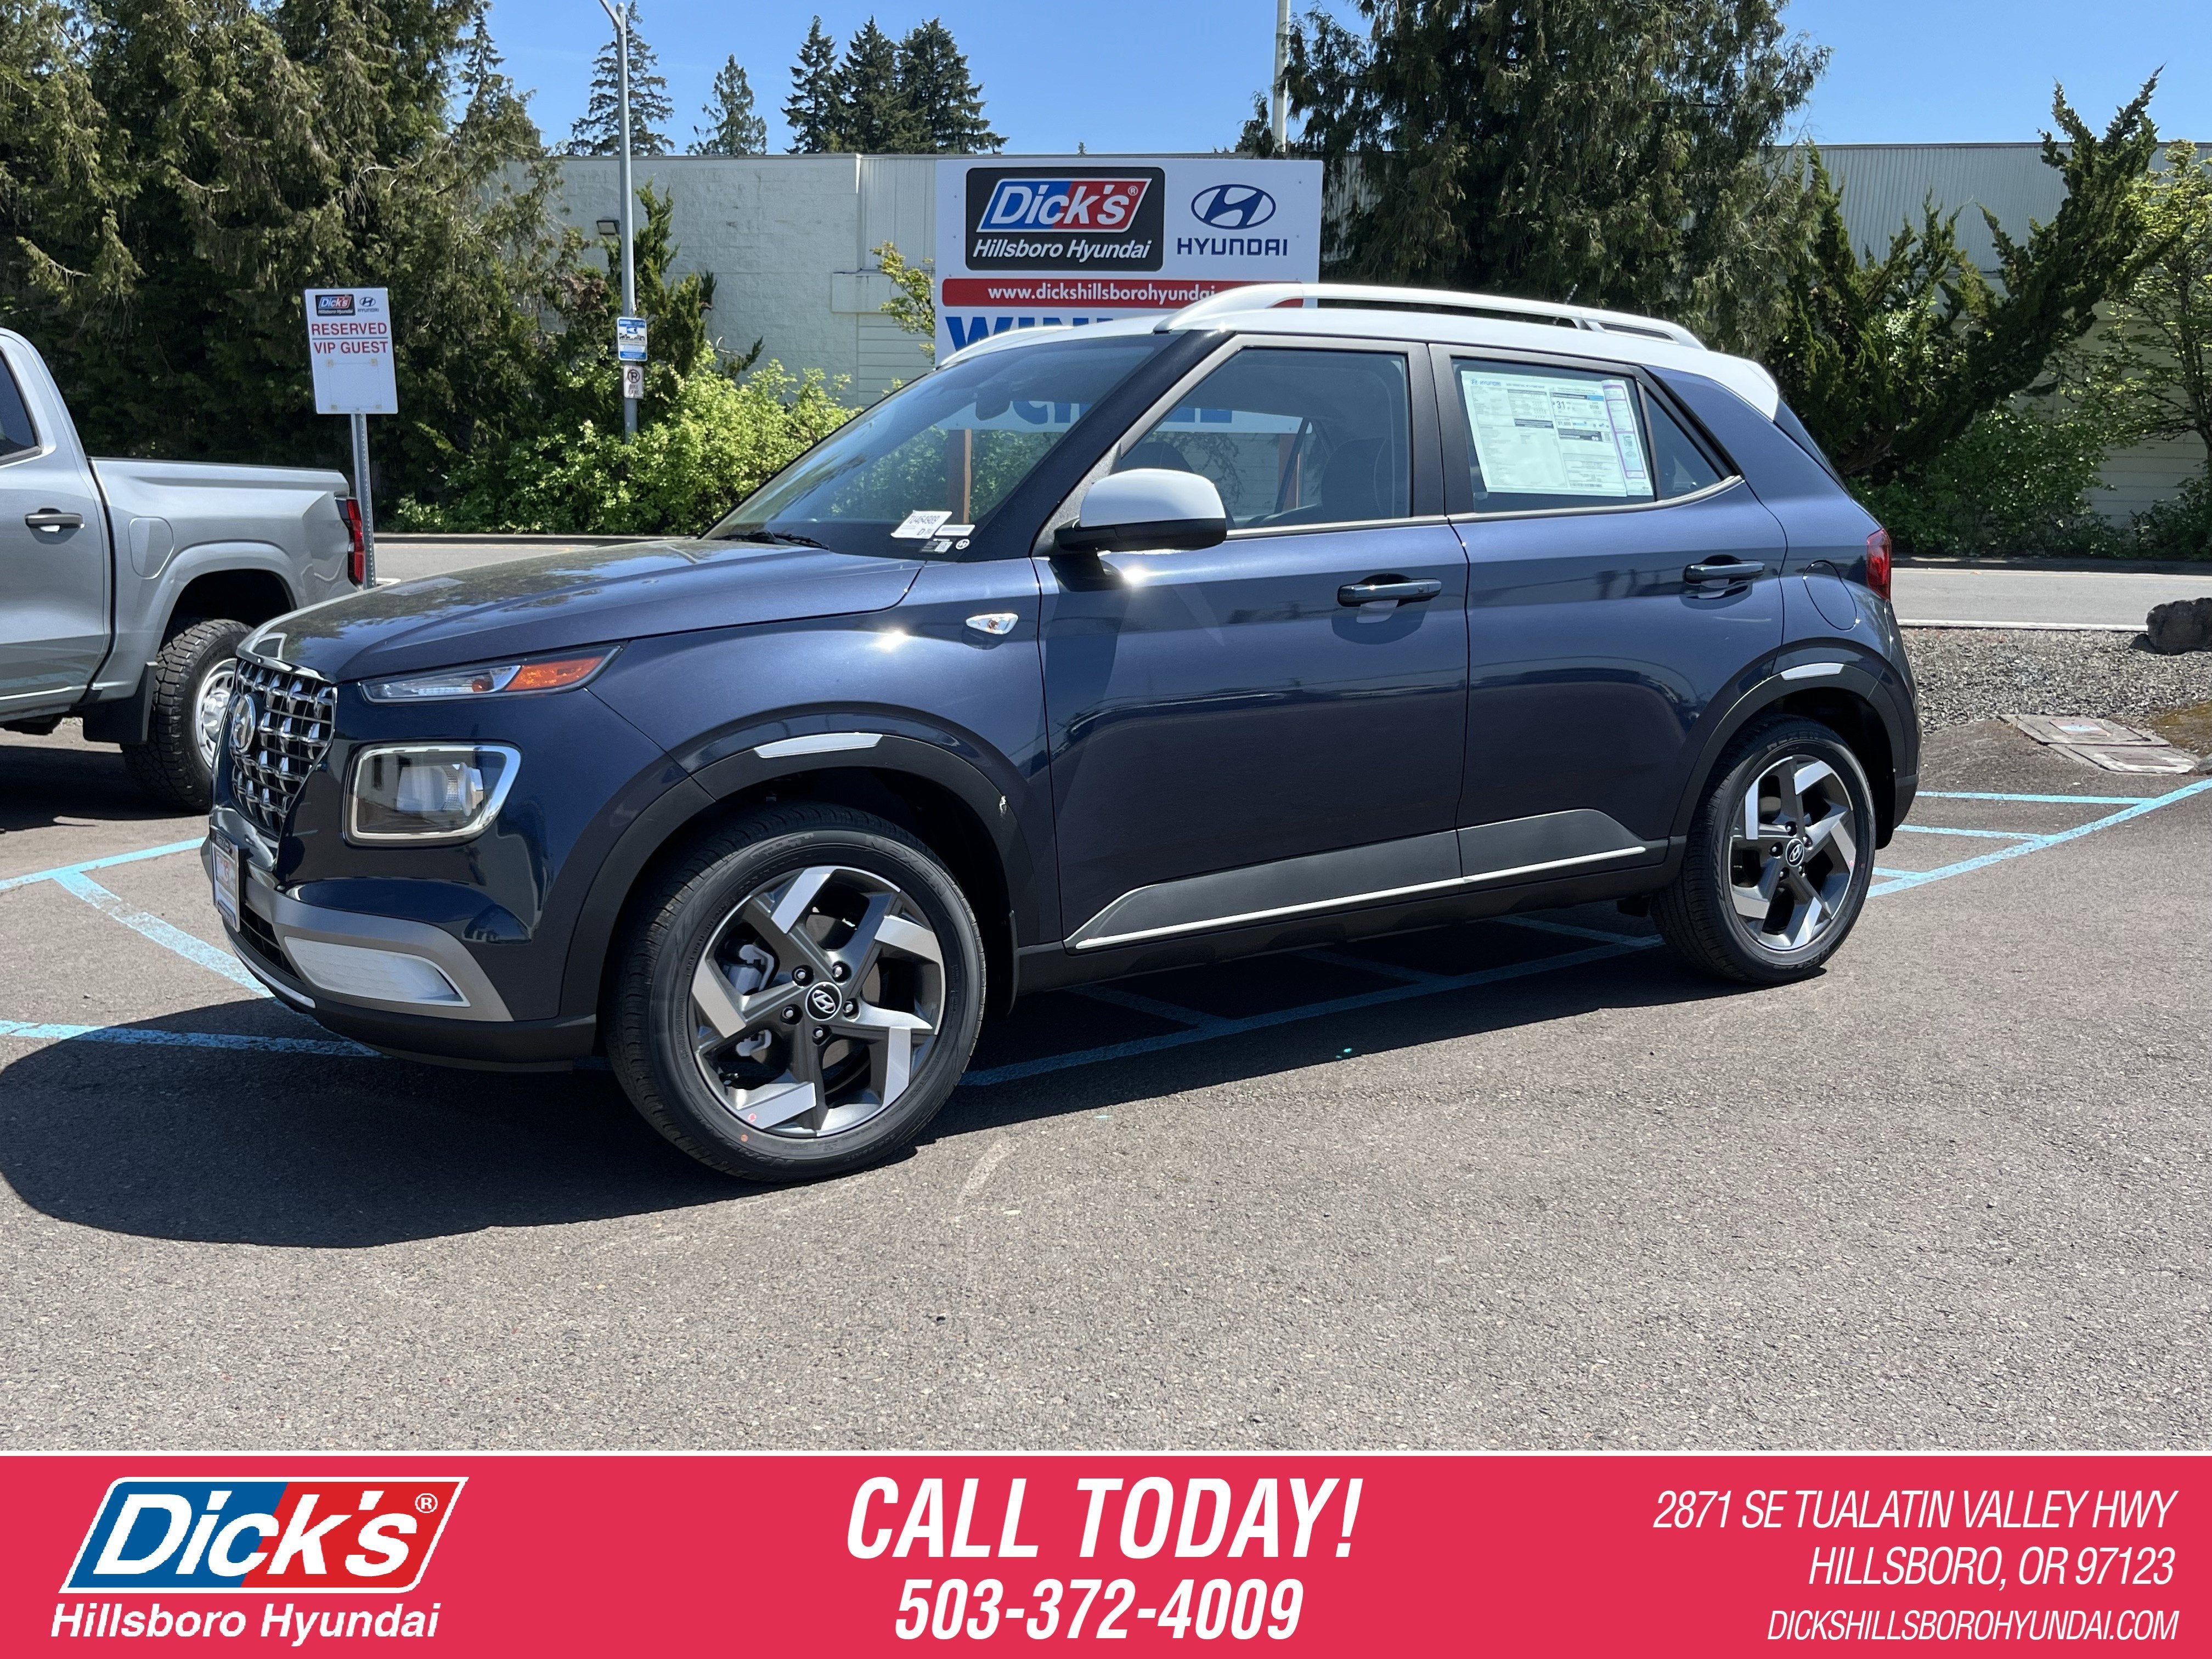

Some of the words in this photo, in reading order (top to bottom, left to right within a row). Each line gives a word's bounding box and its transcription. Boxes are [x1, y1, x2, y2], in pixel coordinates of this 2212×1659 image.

[990, 184, 1130, 225] Dick's
[973, 239, 1064, 257] Hillsboro
[1066, 240, 1152, 263] Hyundai
[1177, 237, 1288, 256] HYUNDAI
[311, 322, 387, 336] RESERVED
[314, 342, 336, 354] VIP
[340, 341, 388, 354] GUEST
